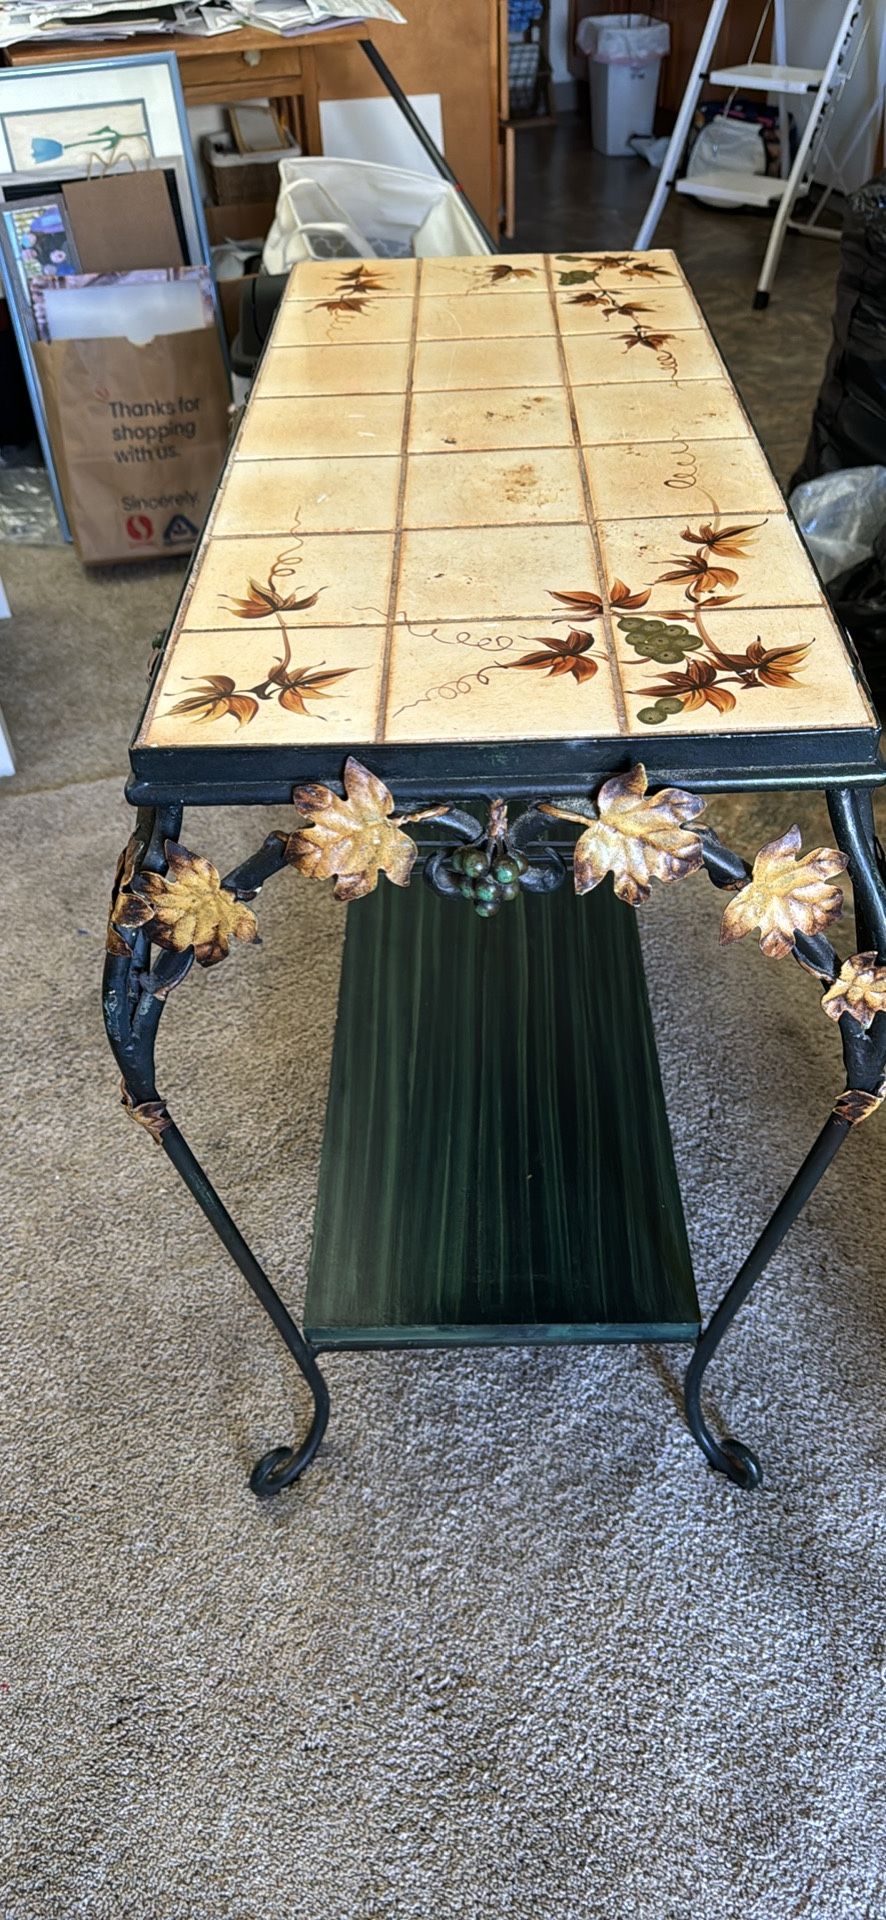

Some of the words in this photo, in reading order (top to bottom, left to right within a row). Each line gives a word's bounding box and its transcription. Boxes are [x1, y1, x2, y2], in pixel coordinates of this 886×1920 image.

[109, 399, 176, 418] Thanks
[178, 396, 200, 414] for
[112, 421, 196, 443] shopping
[113, 445, 153, 463] with
